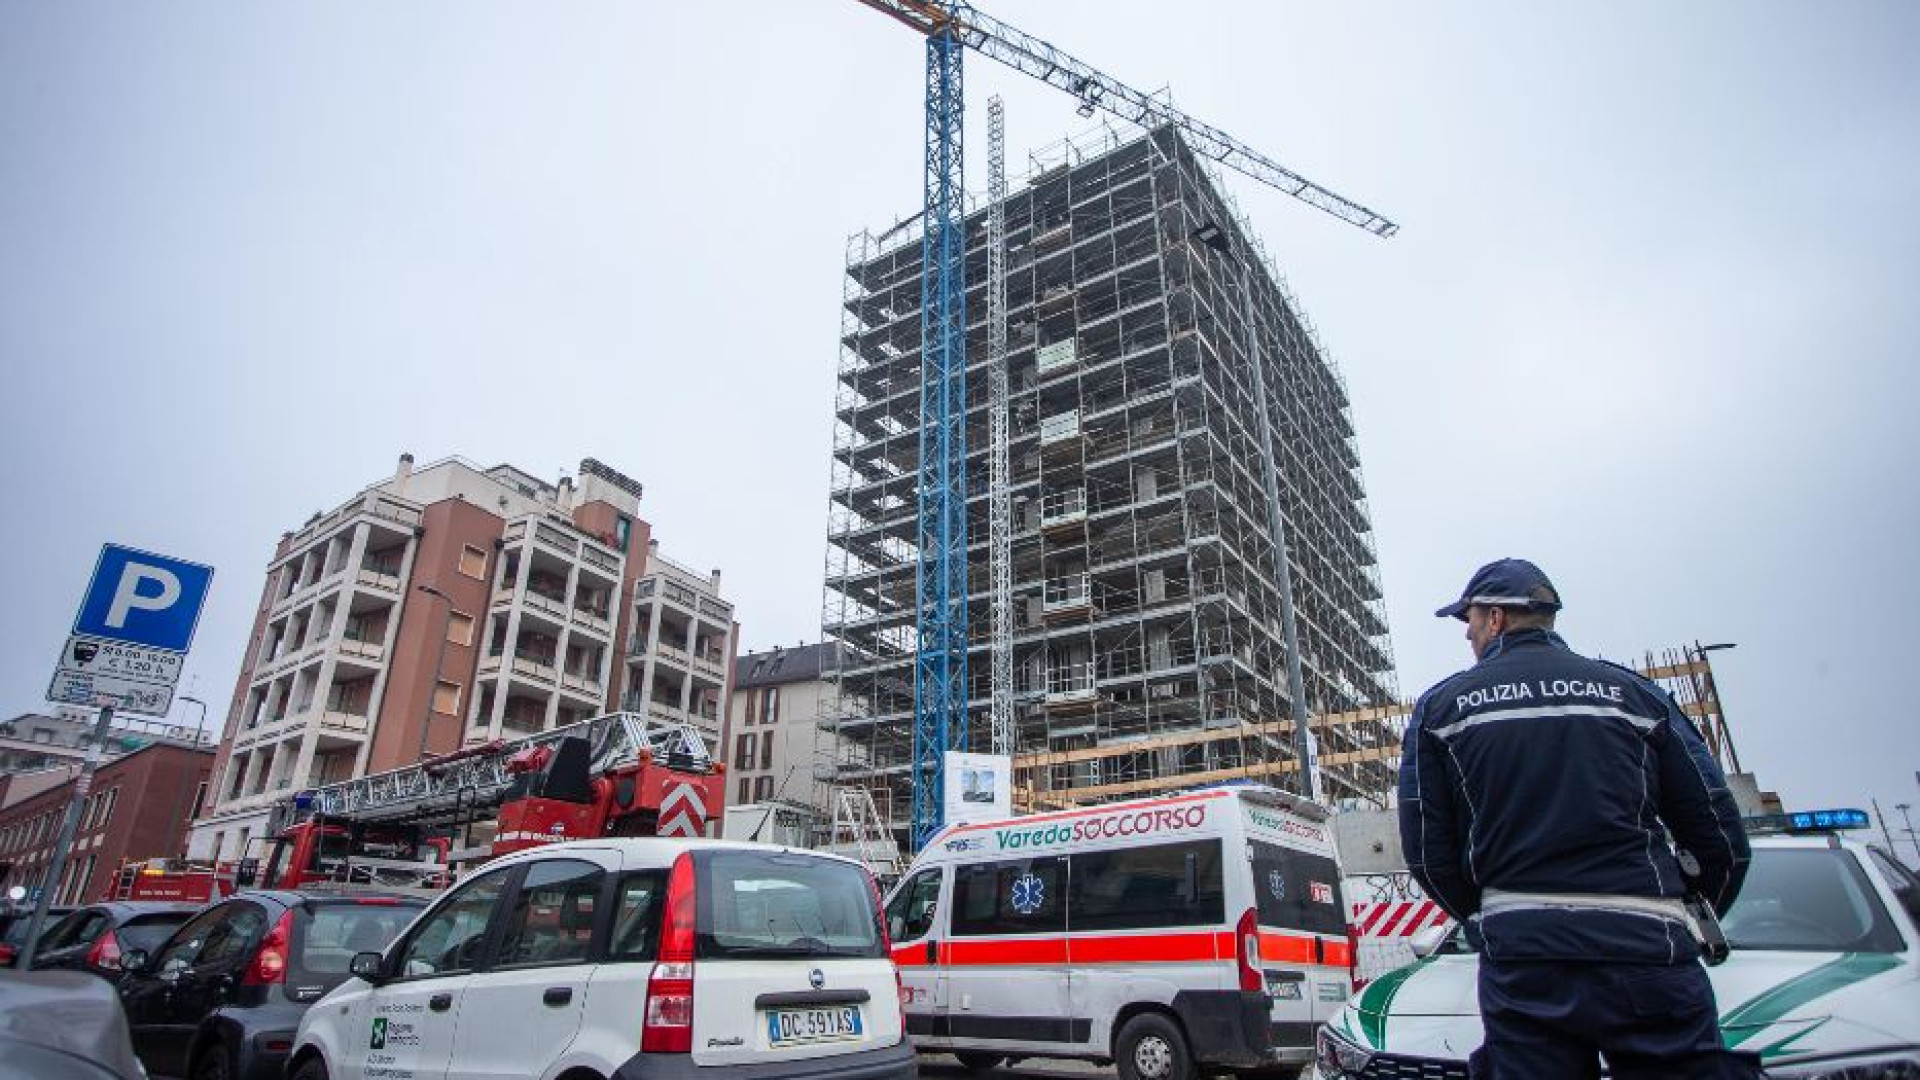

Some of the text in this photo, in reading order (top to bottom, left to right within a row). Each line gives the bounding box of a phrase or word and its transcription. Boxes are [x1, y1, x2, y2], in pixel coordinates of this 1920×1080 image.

[105, 561, 182, 629] P
[1456, 680, 1623, 712] POLIZIA LOCALE
[782, 1013, 803, 1038] DC
